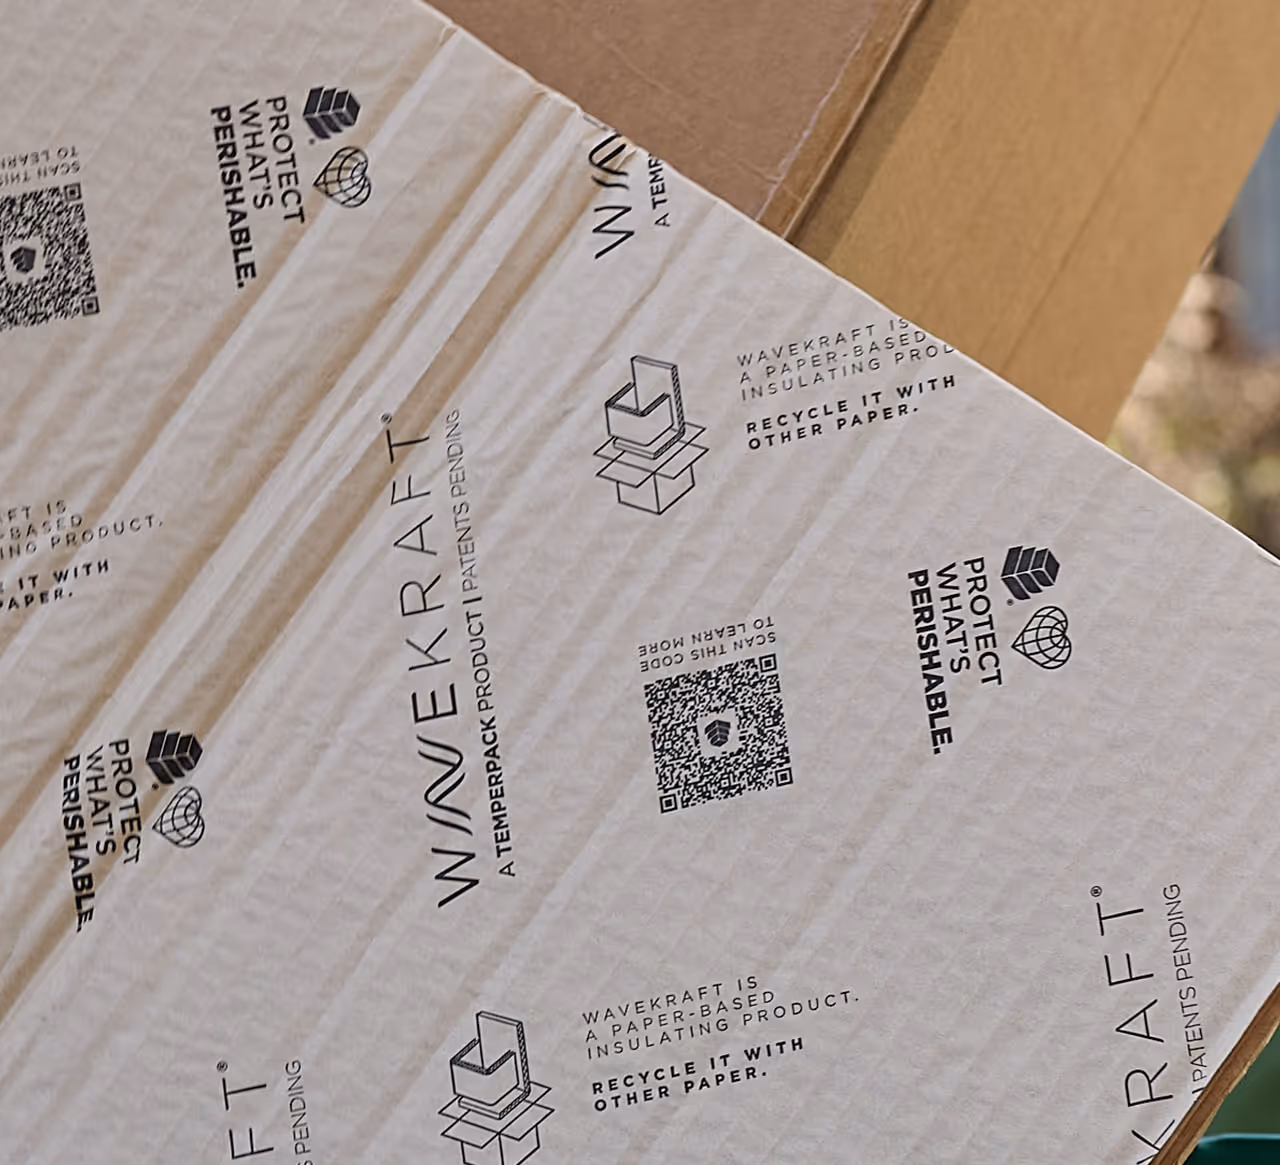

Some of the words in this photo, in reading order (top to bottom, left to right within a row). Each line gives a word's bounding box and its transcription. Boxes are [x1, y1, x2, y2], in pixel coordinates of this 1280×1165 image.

[37, 160, 81, 180] SCAN
[56, 145, 80, 161] TO
[238, 99, 274, 210] WHAT'S
[266, 96, 305, 225] PROTECT
[210, 105, 257, 289] PERISHABLE.
[654, 212, 671, 228] A
[736, 323, 877, 368] WAVEKRAFT
[889, 317, 910, 332] IS
[739, 371, 752, 384] A
[766, 330, 928, 379] PAPER-BASED
[740, 357, 882, 401] INSULATING
[746, 400, 849, 435] RECYCLE
[862, 391, 883, 407] IT
[895, 375, 956, 399] WITH
[445, 408, 467, 499] PENDING
[748, 423, 823, 450] OTHER
[836, 403, 919, 430] PAPER.
[47, 499, 67, 516] IS
[50, 514, 164, 551] PRODUCT.
[452, 500, 479, 593] PATENTS
[19, 574, 40, 591] IT
[52, 559, 110, 584] WITH
[691, 622, 747, 645] LEARN
[733, 631, 777, 651] SCAN
[753, 615, 776, 630] TO
[936, 561, 971, 674] WHAT'S
[963, 556, 1003, 686] PROTECT
[466, 610, 495, 713] PRODUCT
[638, 636, 684, 657] MORE
[640, 653, 684, 673] CODE
[690, 644, 728, 661] THIS
[907, 568, 954, 755] PERISHABLE.
[86, 744, 117, 857] WHAT'S
[108, 738, 142, 865] PROTECT
[479, 714, 513, 859] TEMPERPACK
[62, 753, 96, 934] PERISHABLE.
[498, 860, 516, 878] A
[1162, 883, 1195, 982] PENDING
[582, 983, 725, 1025] WAVEKRAFT
[737, 975, 759, 992] IS
[585, 1029, 598, 1043] A
[611, 990, 776, 1038] PAPER-BASED
[587, 1017, 730, 1060] INSULATING
[742, 990, 860, 1027] PRODUCT.
[1178, 985, 1209, 1084] PATENTS
[592, 1061, 697, 1095] RECYCLE
[709, 1053, 732, 1070] IT
[743, 1037, 805, 1062] WITH
[594, 1085, 670, 1112] OTHER
[683, 1066, 768, 1094] PAPER.
[285, 1058, 311, 1156] PENDING
